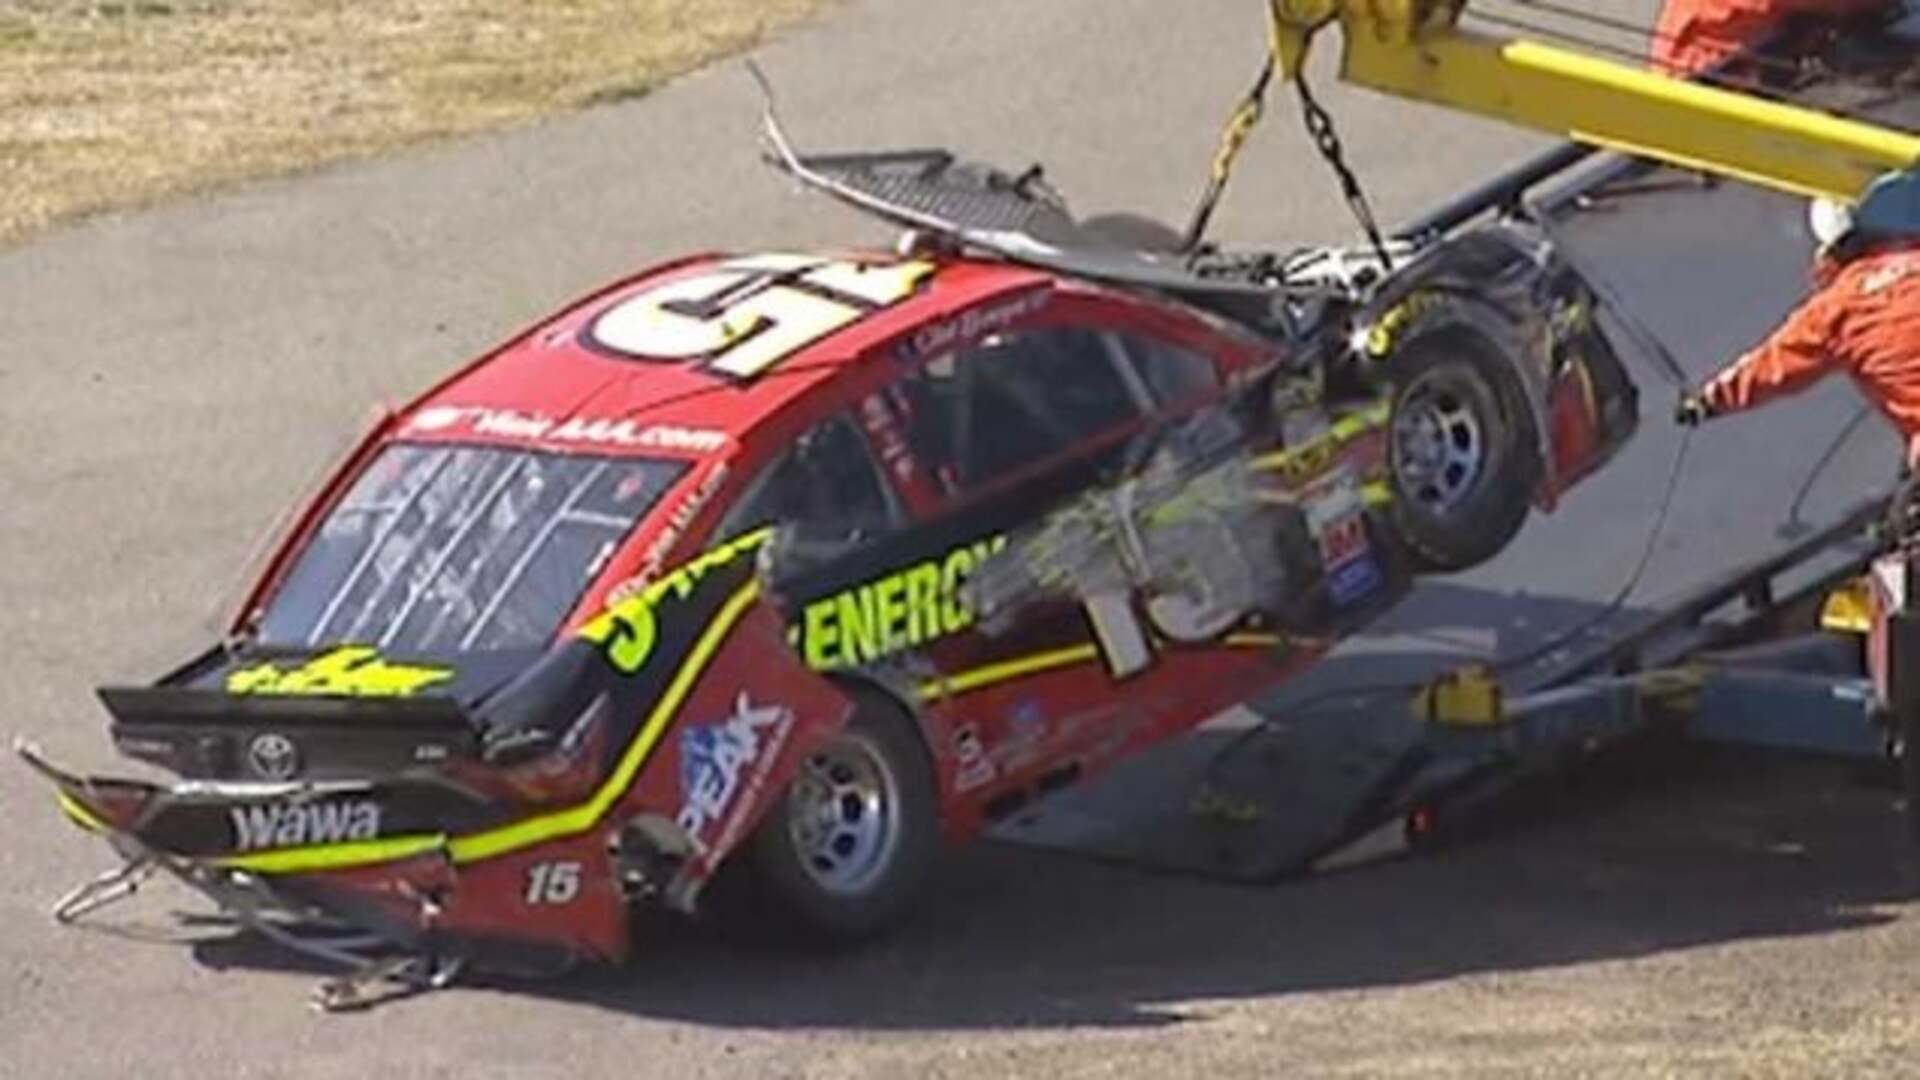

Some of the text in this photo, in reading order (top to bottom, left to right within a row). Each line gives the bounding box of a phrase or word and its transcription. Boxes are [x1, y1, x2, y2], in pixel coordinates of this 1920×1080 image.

[546, 419, 728, 451] AAA.com
[676, 691, 784, 858] PEAK
[232, 801, 382, 850] Wawa
[525, 862, 580, 903] 15
